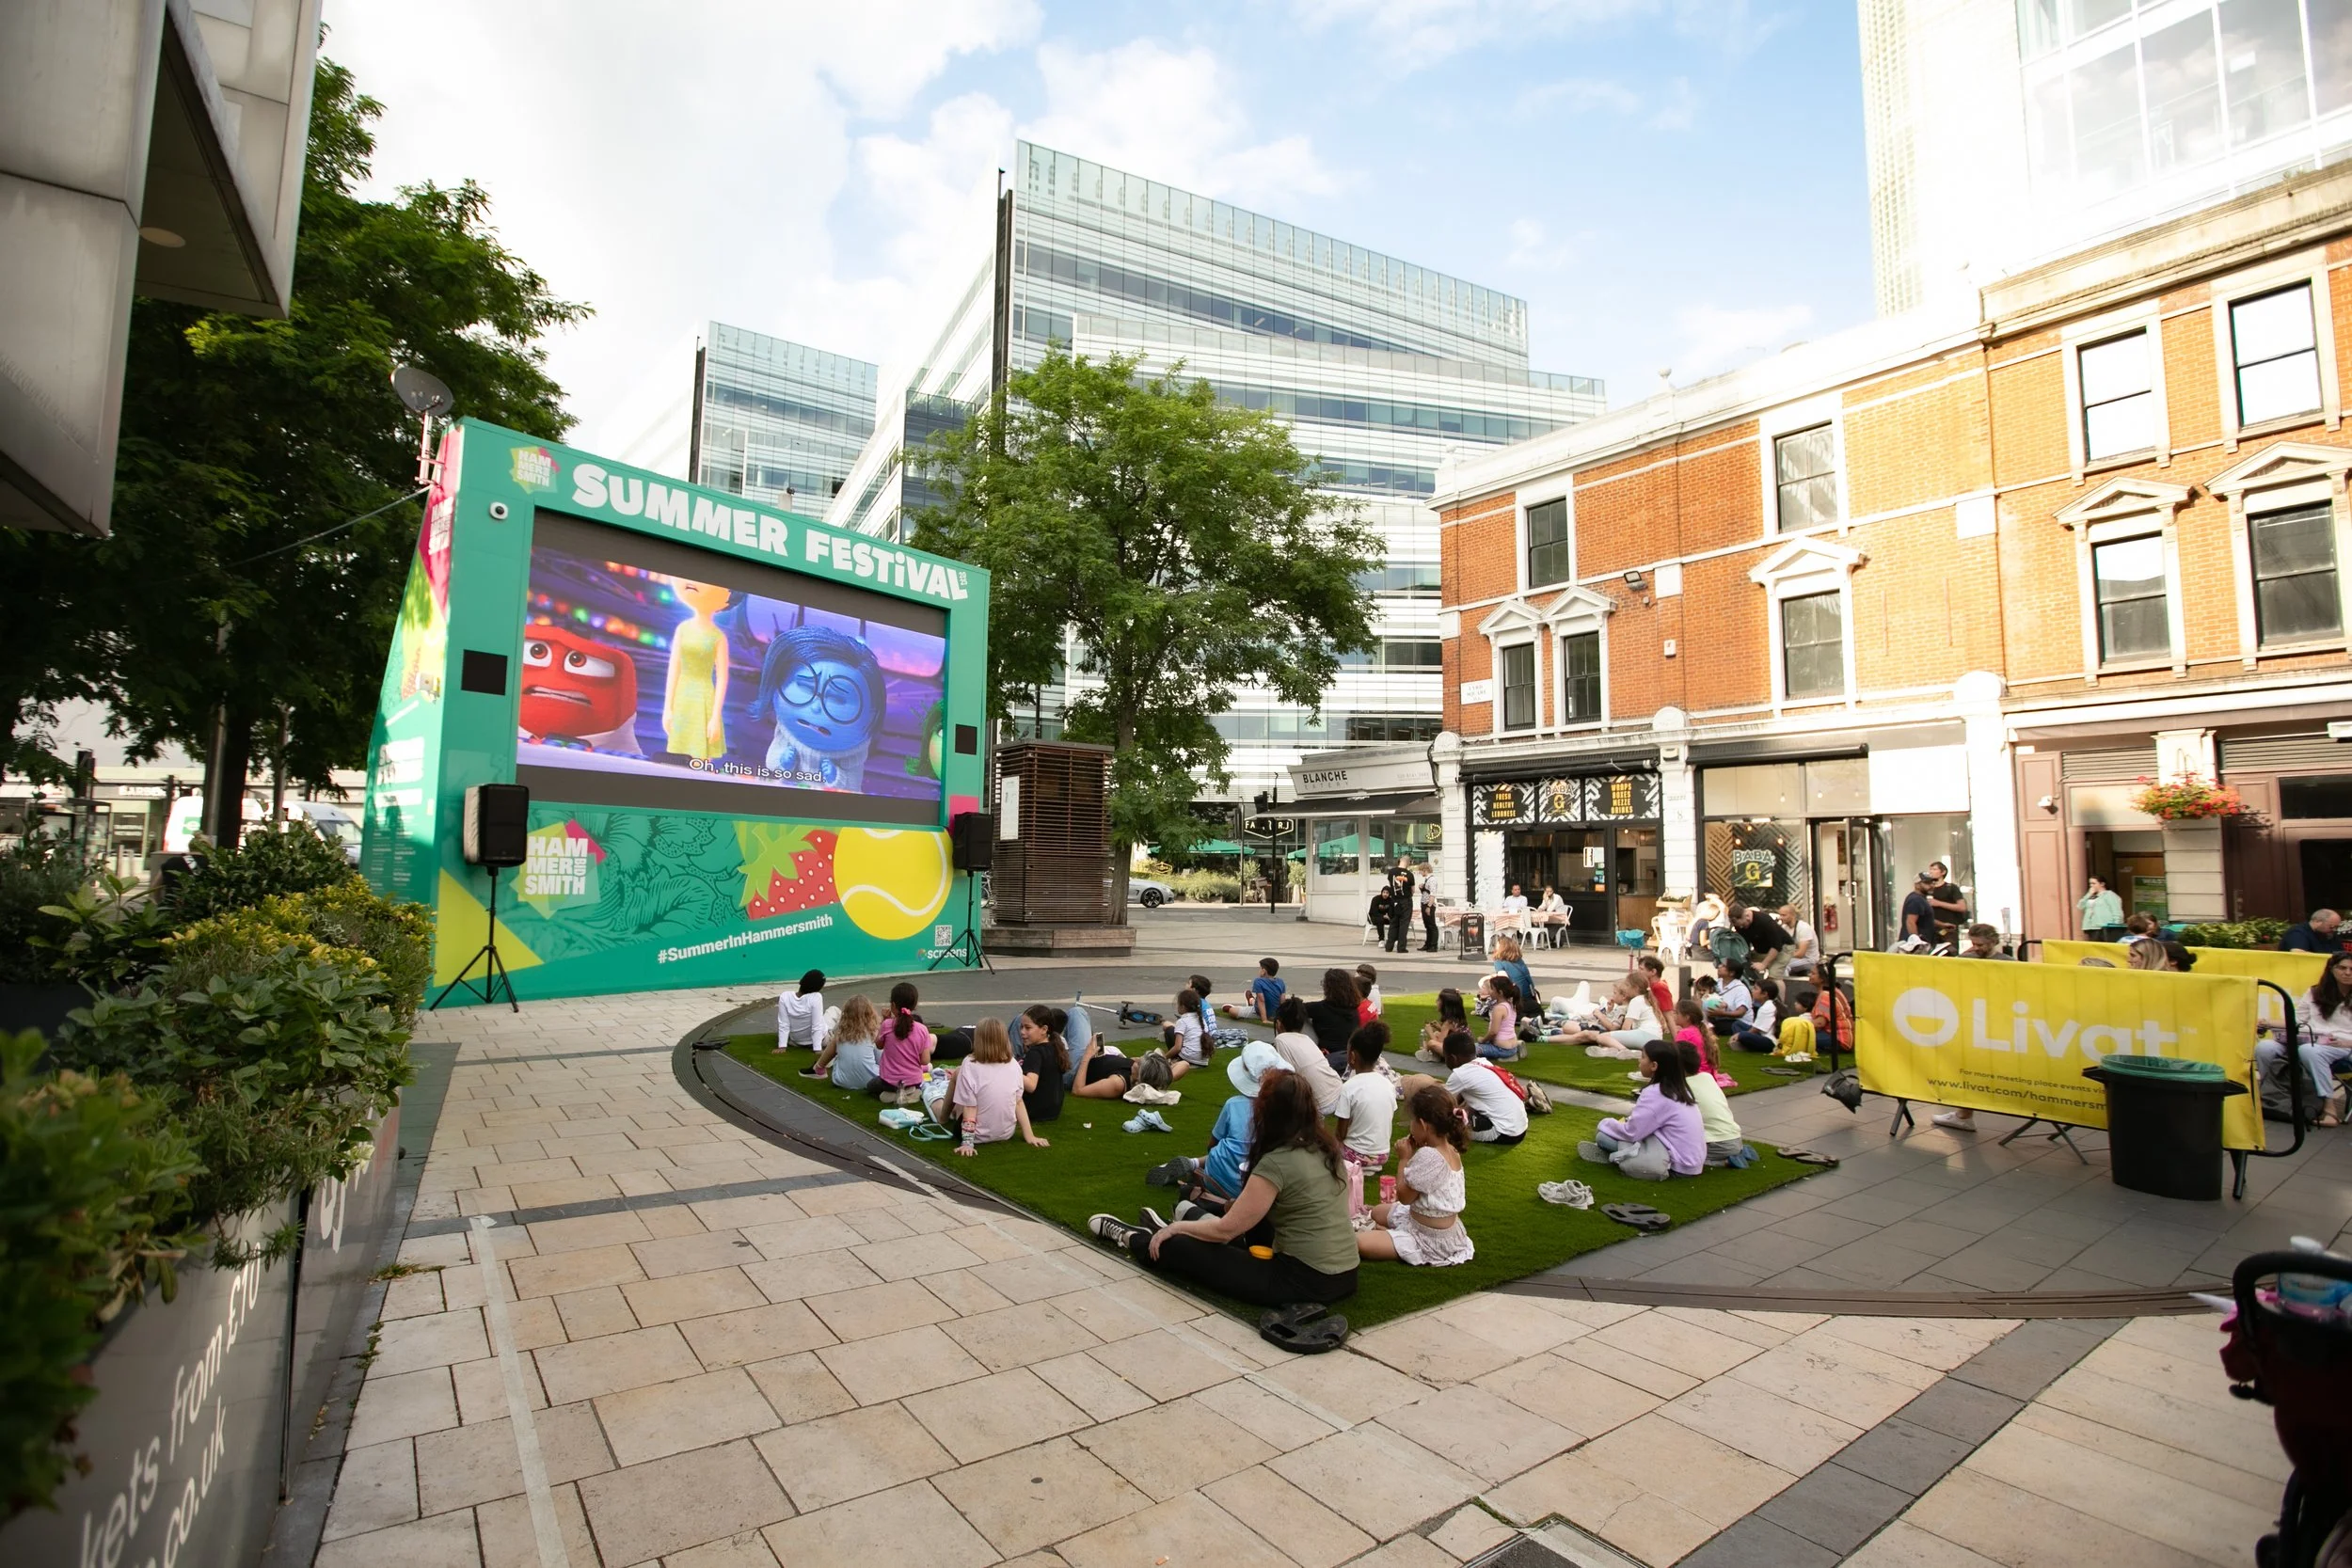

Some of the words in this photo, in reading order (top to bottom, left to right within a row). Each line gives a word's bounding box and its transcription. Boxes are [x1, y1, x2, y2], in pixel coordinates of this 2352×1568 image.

[571, 463, 788, 557] SUMMER
[689, 758, 719, 773] Oh,
[723, 762, 753, 775] this
[756, 765, 771, 777] is
[796, 771, 826, 783] sad.
[1302, 770, 1348, 784] BLANCHE
[1545, 785, 1575, 797] BABA
[1553, 795, 1565, 810] G
[1613, 798, 1631, 806] MEZZE
[1491, 810, 1516, 818] LEBANESE
[527, 836, 589, 858] HAM
[526, 856, 574, 875] MER
[1733, 849, 1774, 866] BABA
[1745, 862, 1760, 880] G
[525, 875, 587, 895] SMITH
[657, 913, 834, 964] #SummerInHammersmith
[927, 948, 967, 959] screens
[1973, 997, 2179, 1064] Livat
[1959, 1068, 1973, 1076] For
[1974, 1070, 1995, 1080] more
[1996, 1074, 2033, 1085] meeting
[2033, 1079, 2059, 1089] place
[2059, 1085, 2091, 1094] events
[169, 1323, 223, 1465] from
[227, 1241, 262, 1354] £10
